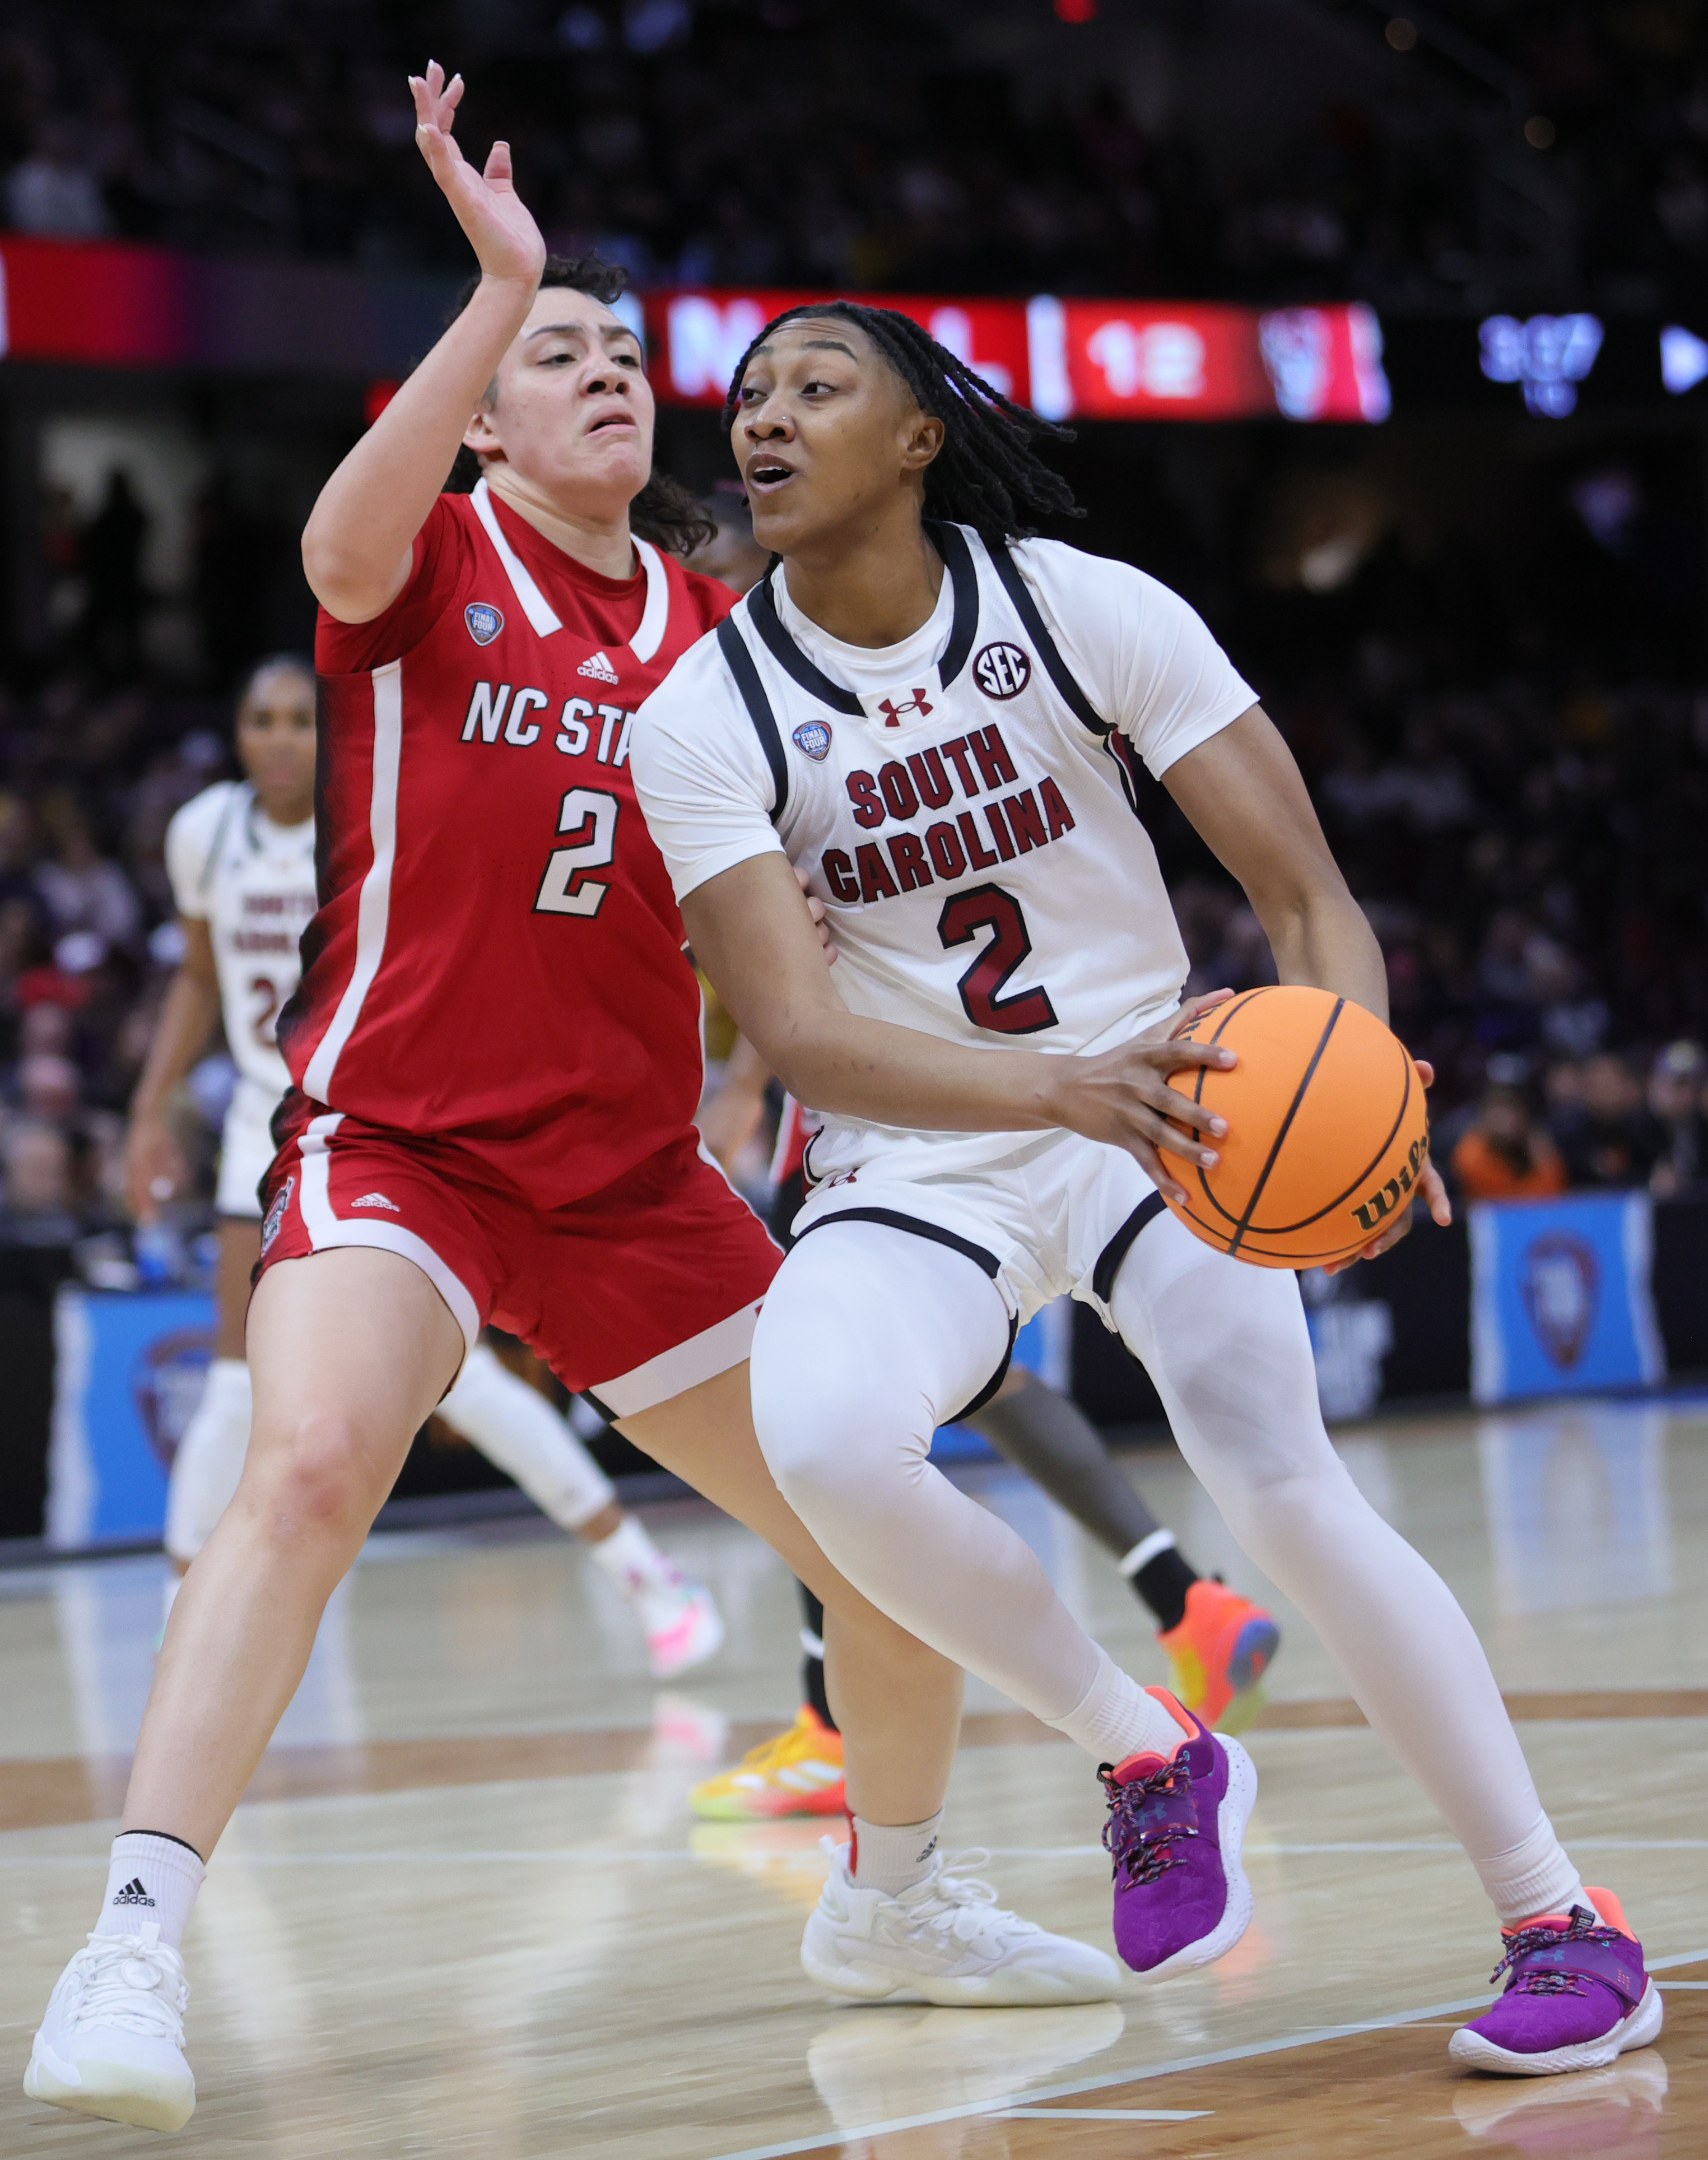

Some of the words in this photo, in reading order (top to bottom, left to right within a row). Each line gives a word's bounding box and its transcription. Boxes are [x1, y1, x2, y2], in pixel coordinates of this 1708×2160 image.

[472, 620, 493, 633] FOUR
[473, 612, 494, 624] FINAL
[576, 665, 619, 685] adidas
[977, 645, 1026, 695] SEC
[459, 680, 549, 747] NC
[801, 728, 823, 742] FINAL
[804, 736, 827, 751] FOUR
[845, 723, 1019, 829] SOUTH
[821, 776, 1076, 903] CAROLINA
[532, 784, 621, 919] 2
[937, 882, 1059, 1035] 2
[351, 1200, 400, 1212] adidas
[113, 1894, 155, 1907] adidas
